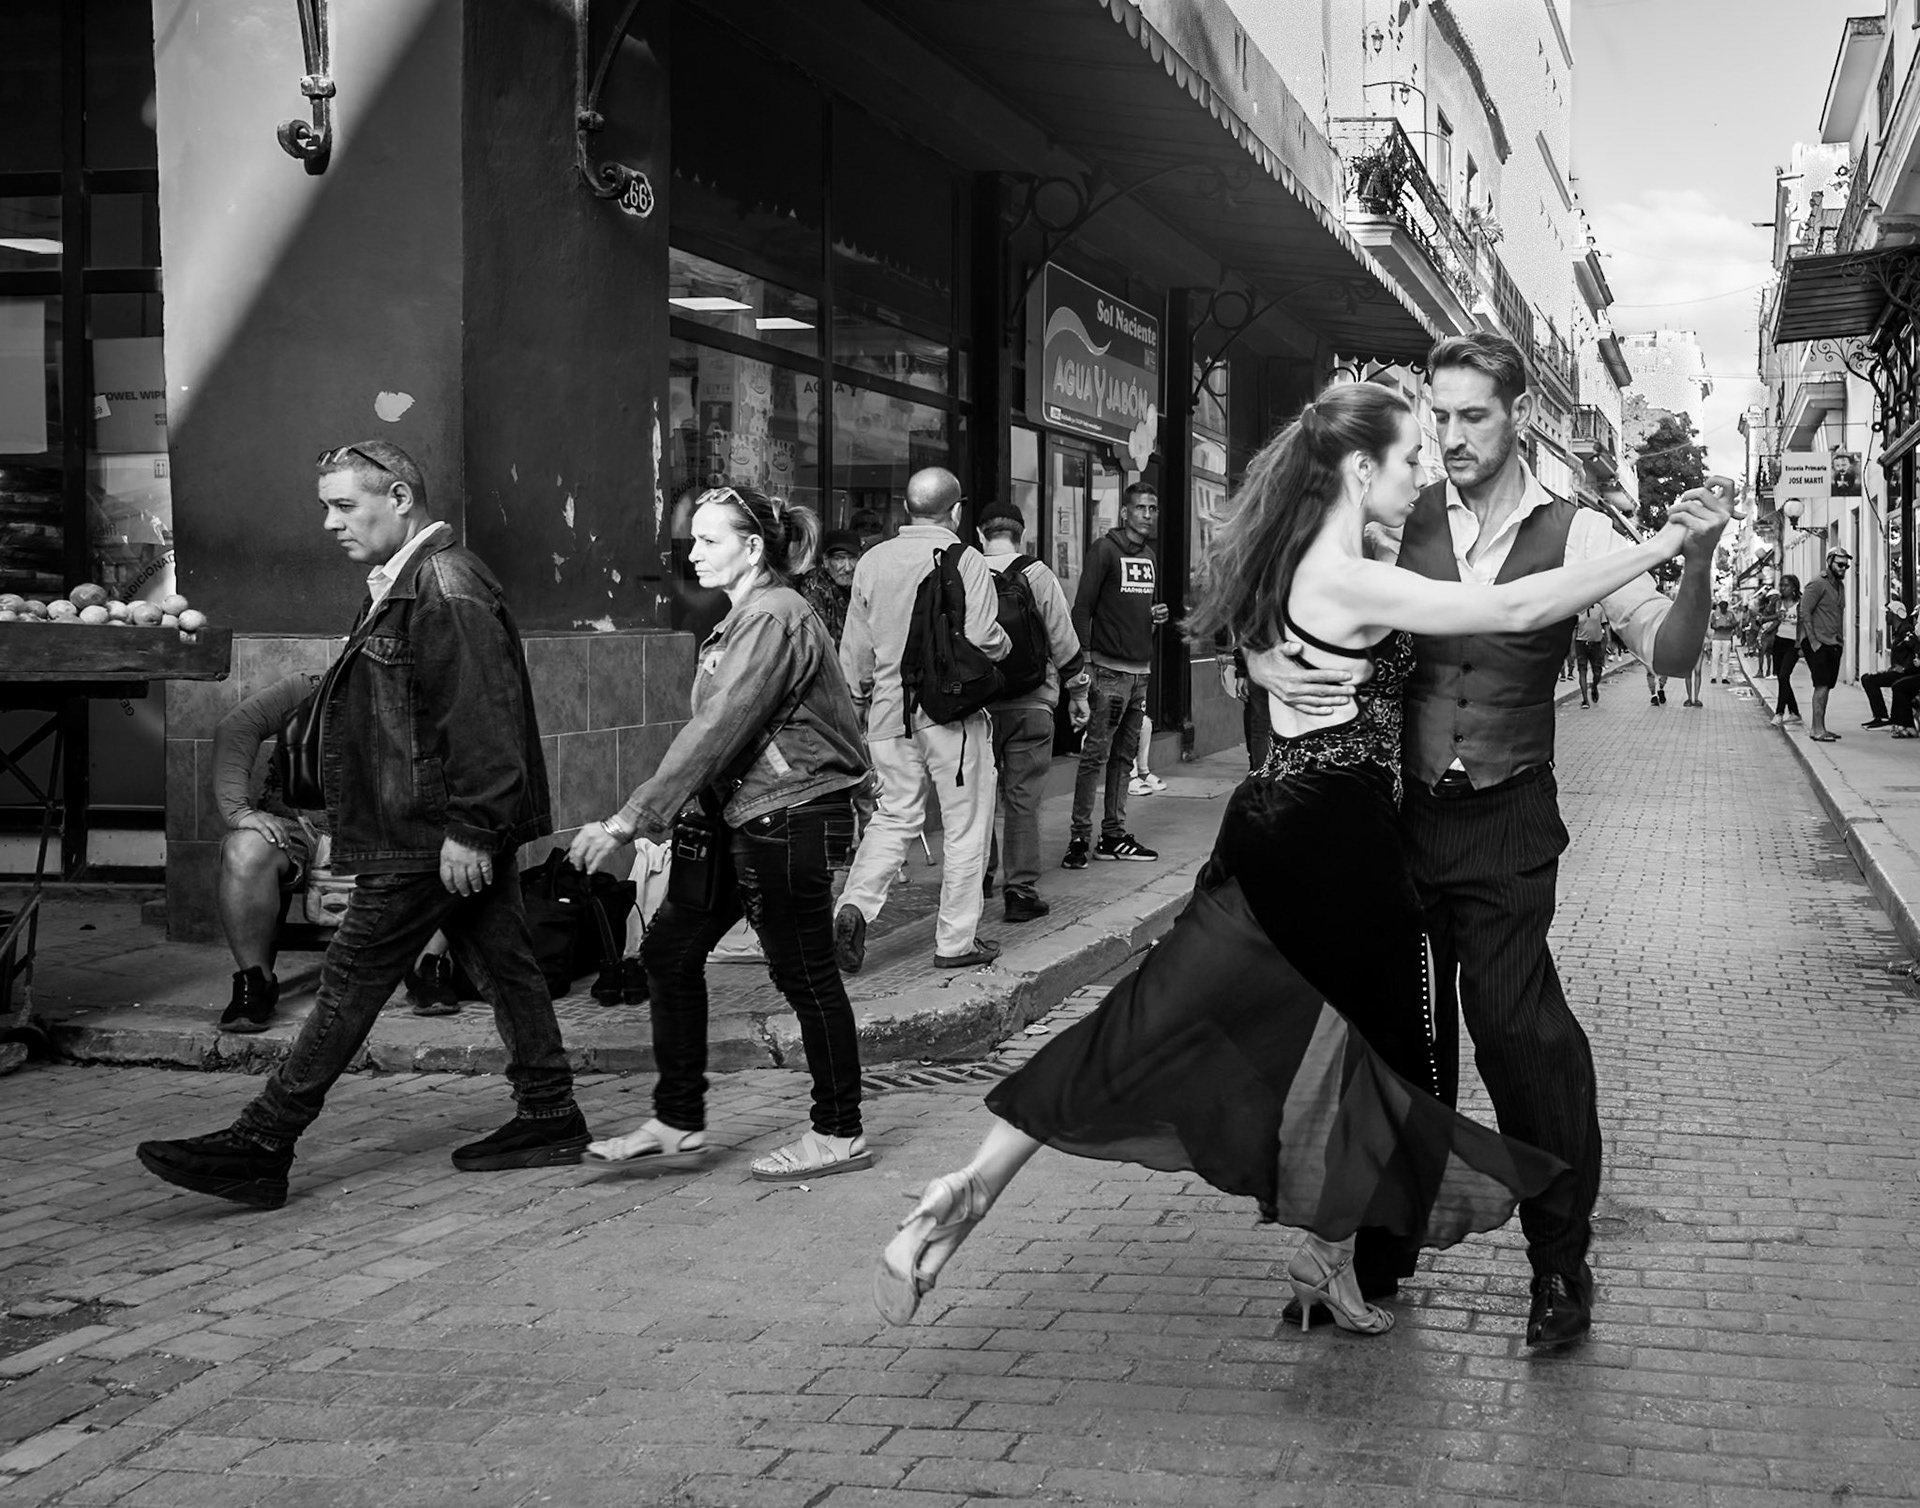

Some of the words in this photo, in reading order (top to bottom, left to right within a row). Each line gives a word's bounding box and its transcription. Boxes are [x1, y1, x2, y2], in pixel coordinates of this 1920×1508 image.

[1097, 298, 1113, 327] Sol
[1115, 306, 1157, 347] Naciente
[99, 391, 138, 401] OWEL
[1053, 355, 1093, 403] AGUA
[1093, 365, 1106, 417] Y
[1106, 377, 1149, 420] JABÓN
[1788, 476, 1803, 484] JOSÉ
[1804, 476, 1824, 484] MARTÍ
